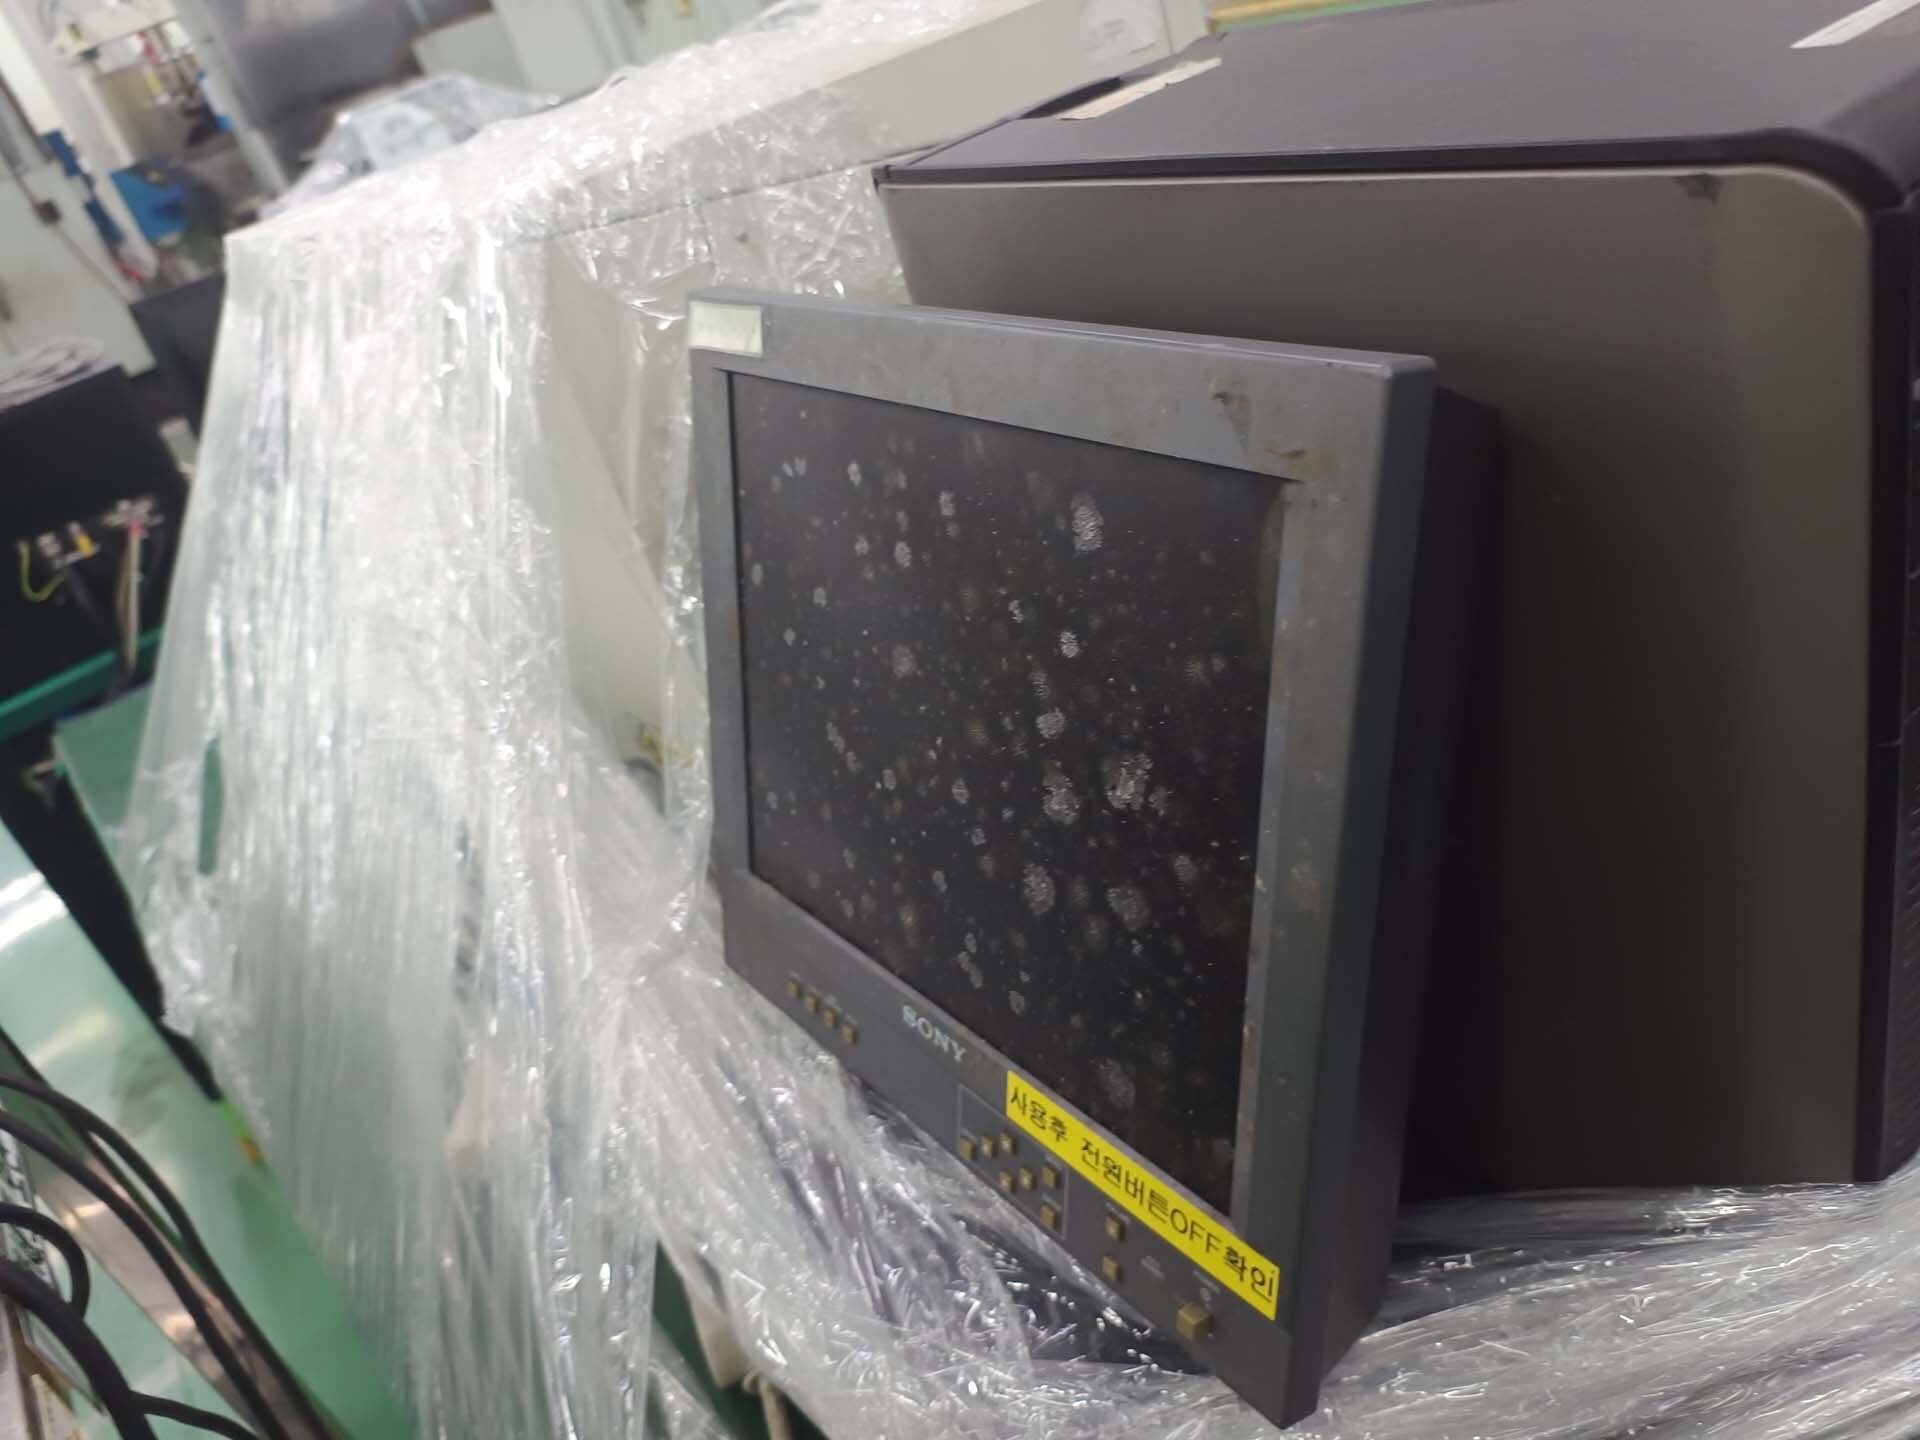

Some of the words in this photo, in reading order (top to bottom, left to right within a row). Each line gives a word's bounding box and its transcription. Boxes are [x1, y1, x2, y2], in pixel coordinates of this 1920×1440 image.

[902, 1005, 968, 1061] SONY
[1010, 1087, 1069, 1143] 사용후
[1080, 1137, 1275, 1302] 전원버튼OFF확인
